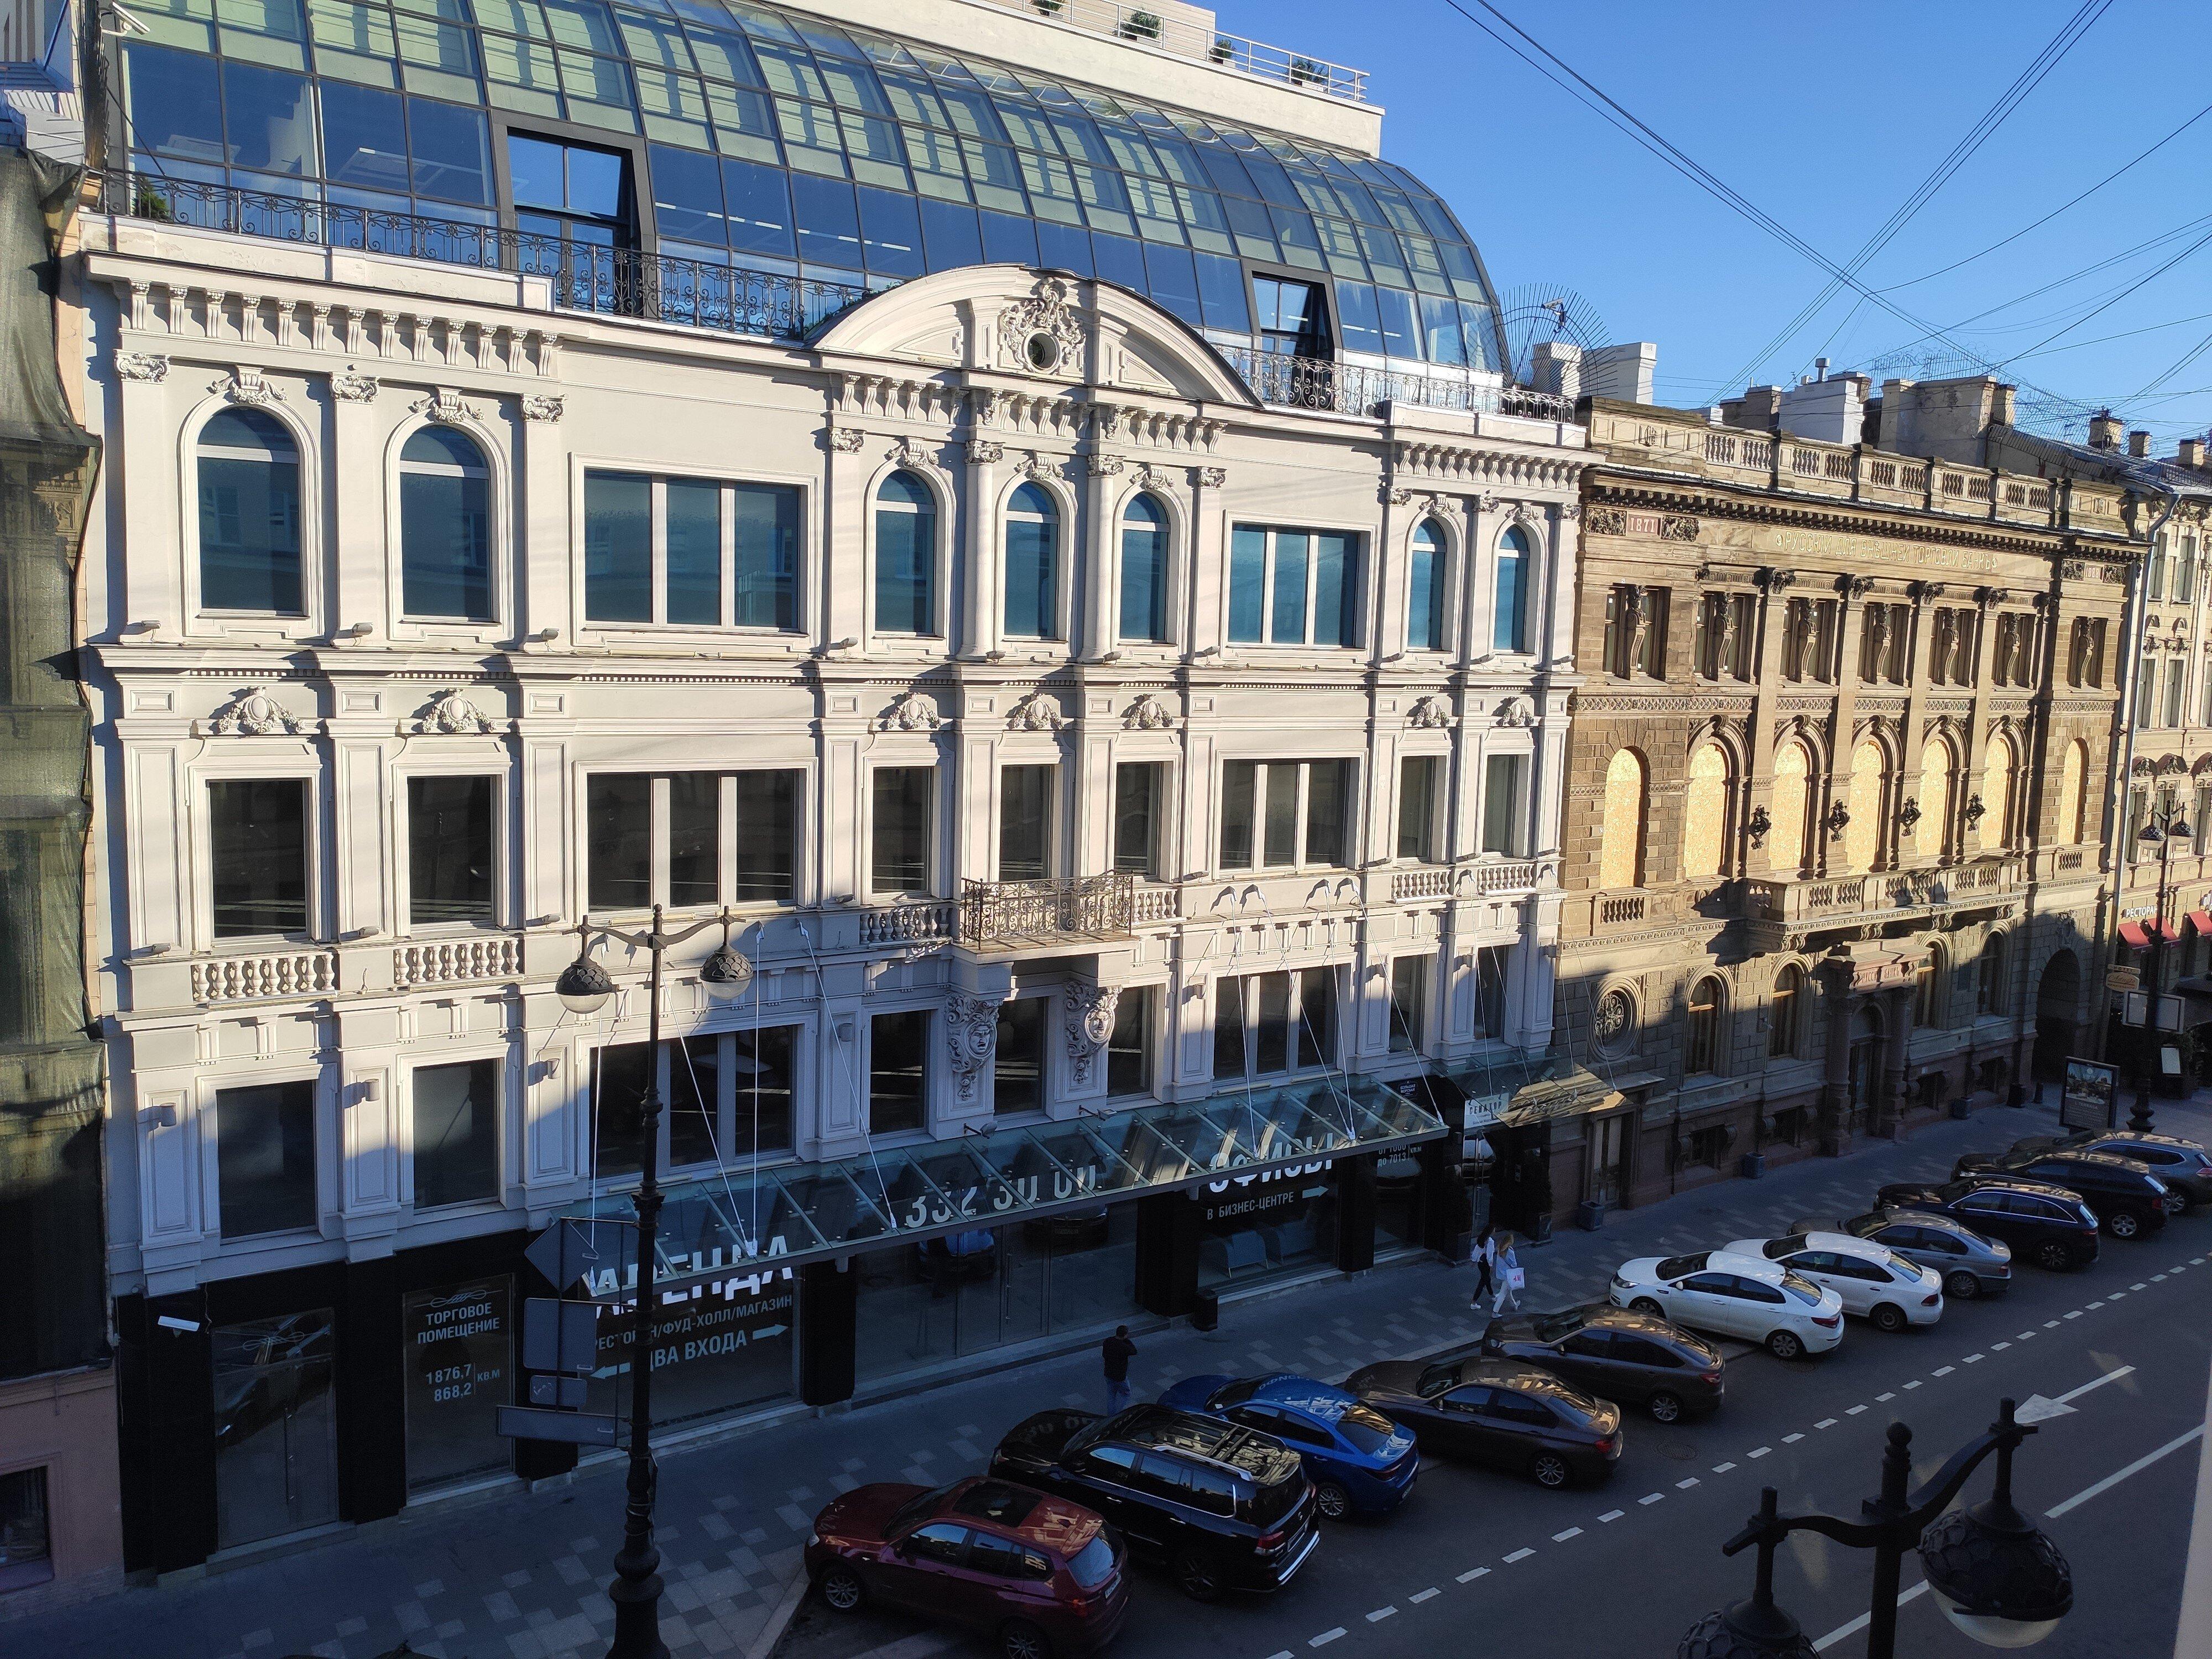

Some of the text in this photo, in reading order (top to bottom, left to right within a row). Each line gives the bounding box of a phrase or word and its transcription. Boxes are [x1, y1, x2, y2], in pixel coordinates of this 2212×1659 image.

[1630, 518, 1655, 533] 1871
[1835, 537, 1857, 556] ДЛЯ
[1469, 1101, 1501, 1114] СЕНАТОР
[1389, 1152, 1406, 1164] 7013
[1207, 1192, 1294, 1220] В БИЗНЕС-ЦЕНТРЕ
[425, 1302, 492, 1326] ТОРГОВОЕ
[418, 1317, 500, 1344] ПОМЕЩЕНИЕ
[685, 1329, 747, 1360] ВХОДА
[425, 1363, 472, 1385] 1876,7
[434, 1383, 472, 1402] 868,2
